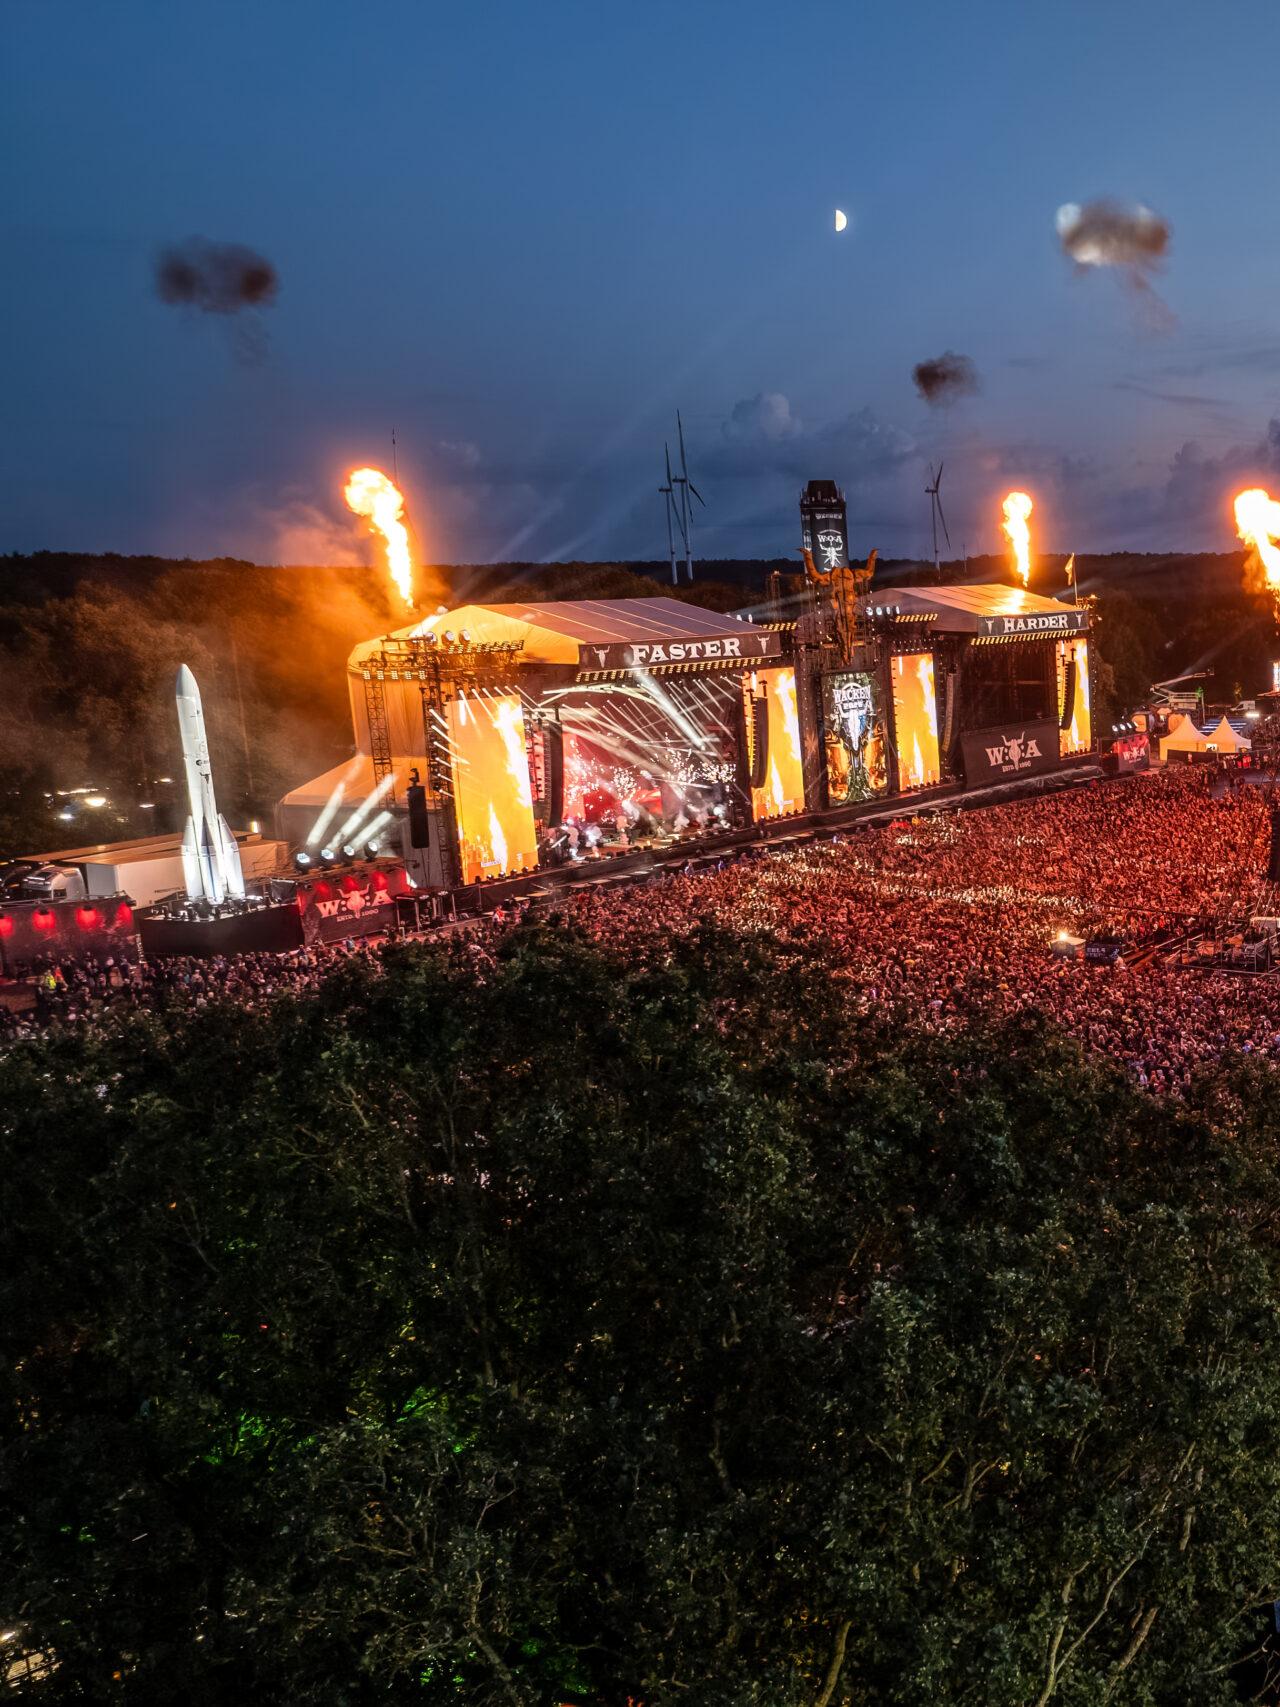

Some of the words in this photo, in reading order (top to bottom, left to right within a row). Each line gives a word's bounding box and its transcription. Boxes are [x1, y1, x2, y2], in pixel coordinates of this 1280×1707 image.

[1003, 614, 1069, 634] HARDER
[630, 638, 742, 666] FASTER
[832, 684, 871, 704] WACKEN
